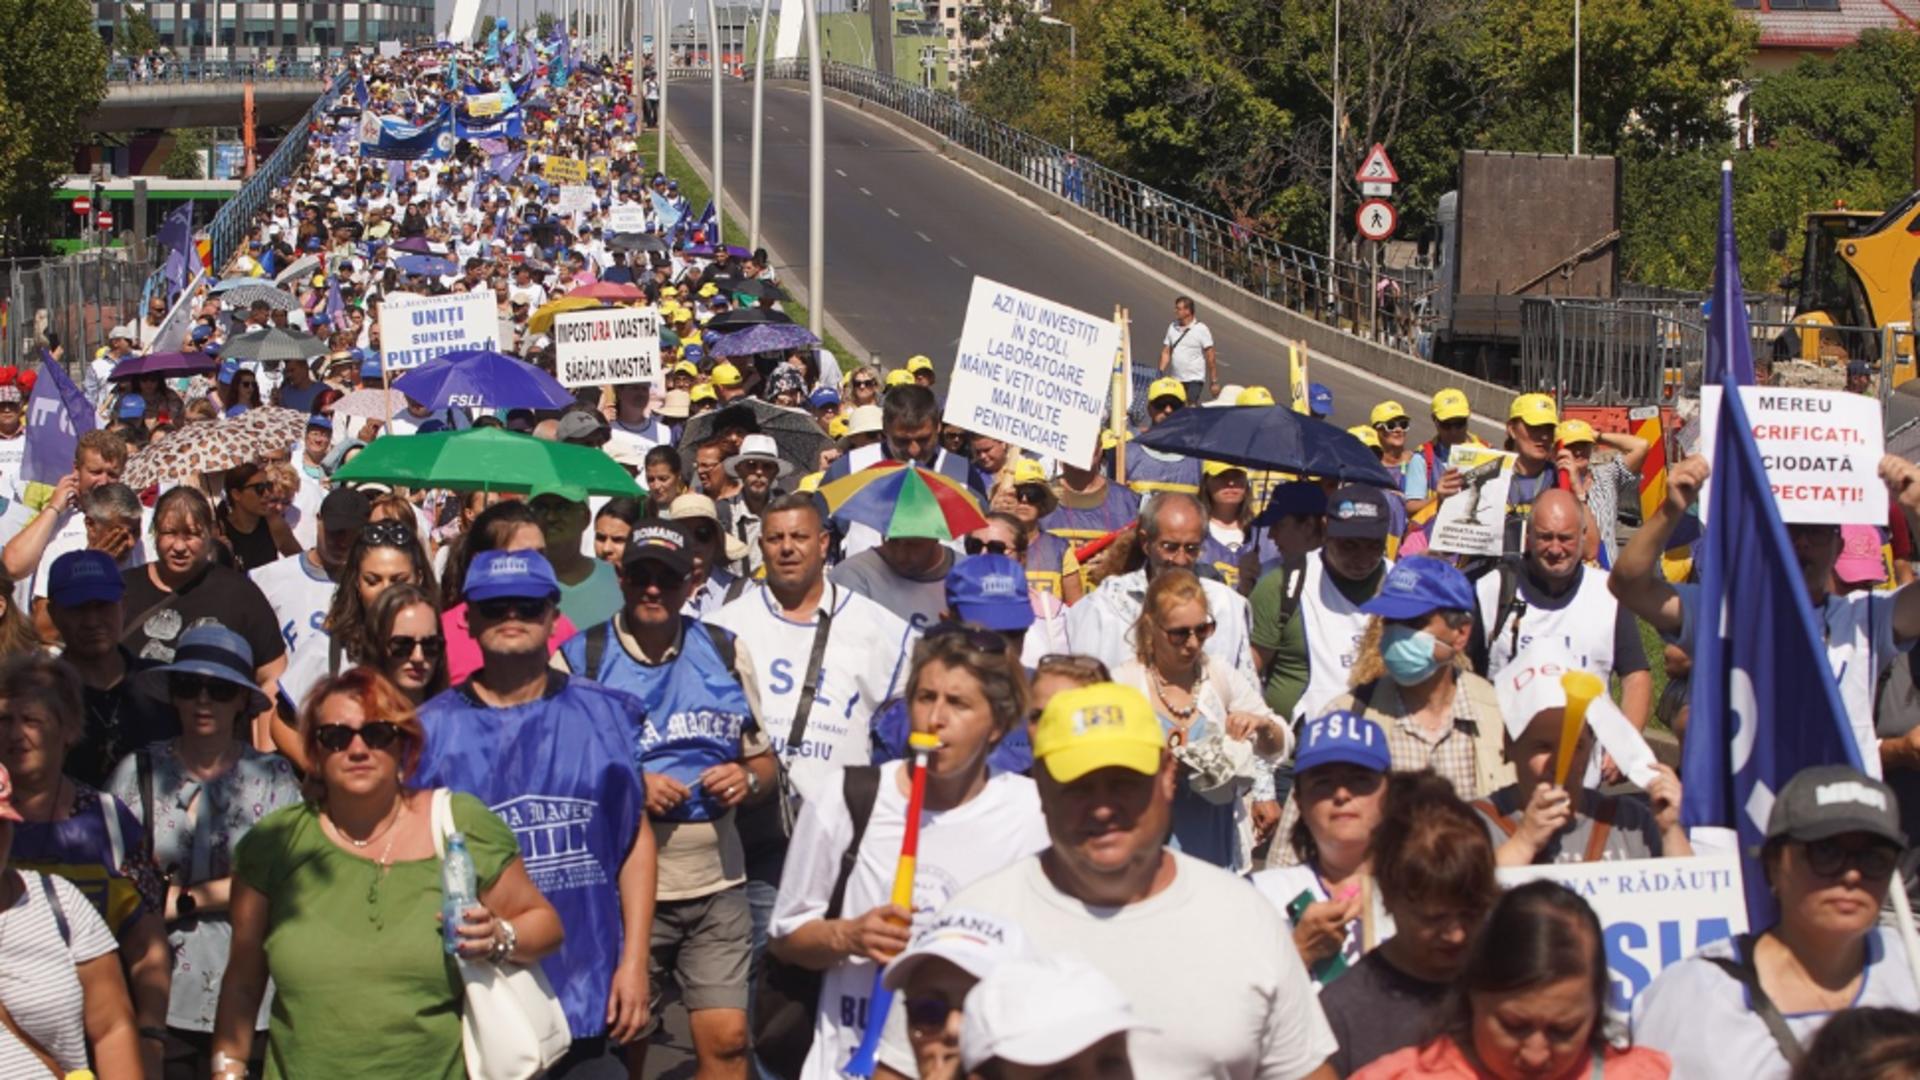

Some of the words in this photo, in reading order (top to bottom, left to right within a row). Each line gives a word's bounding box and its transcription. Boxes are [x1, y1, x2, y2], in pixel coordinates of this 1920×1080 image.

[411, 306, 464, 327] UNIȚI
[558, 320, 611, 344] IMPOSTURA
[613, 311, 657, 340] VOASTRĂ
[992, 293, 1016, 312] AZI
[1017, 300, 1037, 321] NU
[1039, 310, 1100, 347] INVESTIȚI
[411, 328, 465, 345] SUNTEM
[565, 355, 606, 383] SĂRĂCIA
[607, 351, 653, 379] NOASTRĂ
[987, 338, 1085, 387] LABORATOARE
[447, 394, 484, 407] FSLI
[991, 387, 1017, 409] MAI
[1017, 398, 1062, 427] MULTE
[1004, 369, 1034, 395] VEȚI
[1035, 379, 1101, 416] CONSTRUI
[1759, 396, 1832, 413] MEREU
[973, 406, 1069, 453] PENITENCIARE
[1752, 425, 1866, 447] CRIFICAȚI,
[1763, 454, 1853, 473] CIODATĂ
[1771, 485, 1865, 507] PECTAȚI!
[1308, 713, 1374, 749] FSLI
[1618, 868, 1733, 894] RĂDĂUȚI
